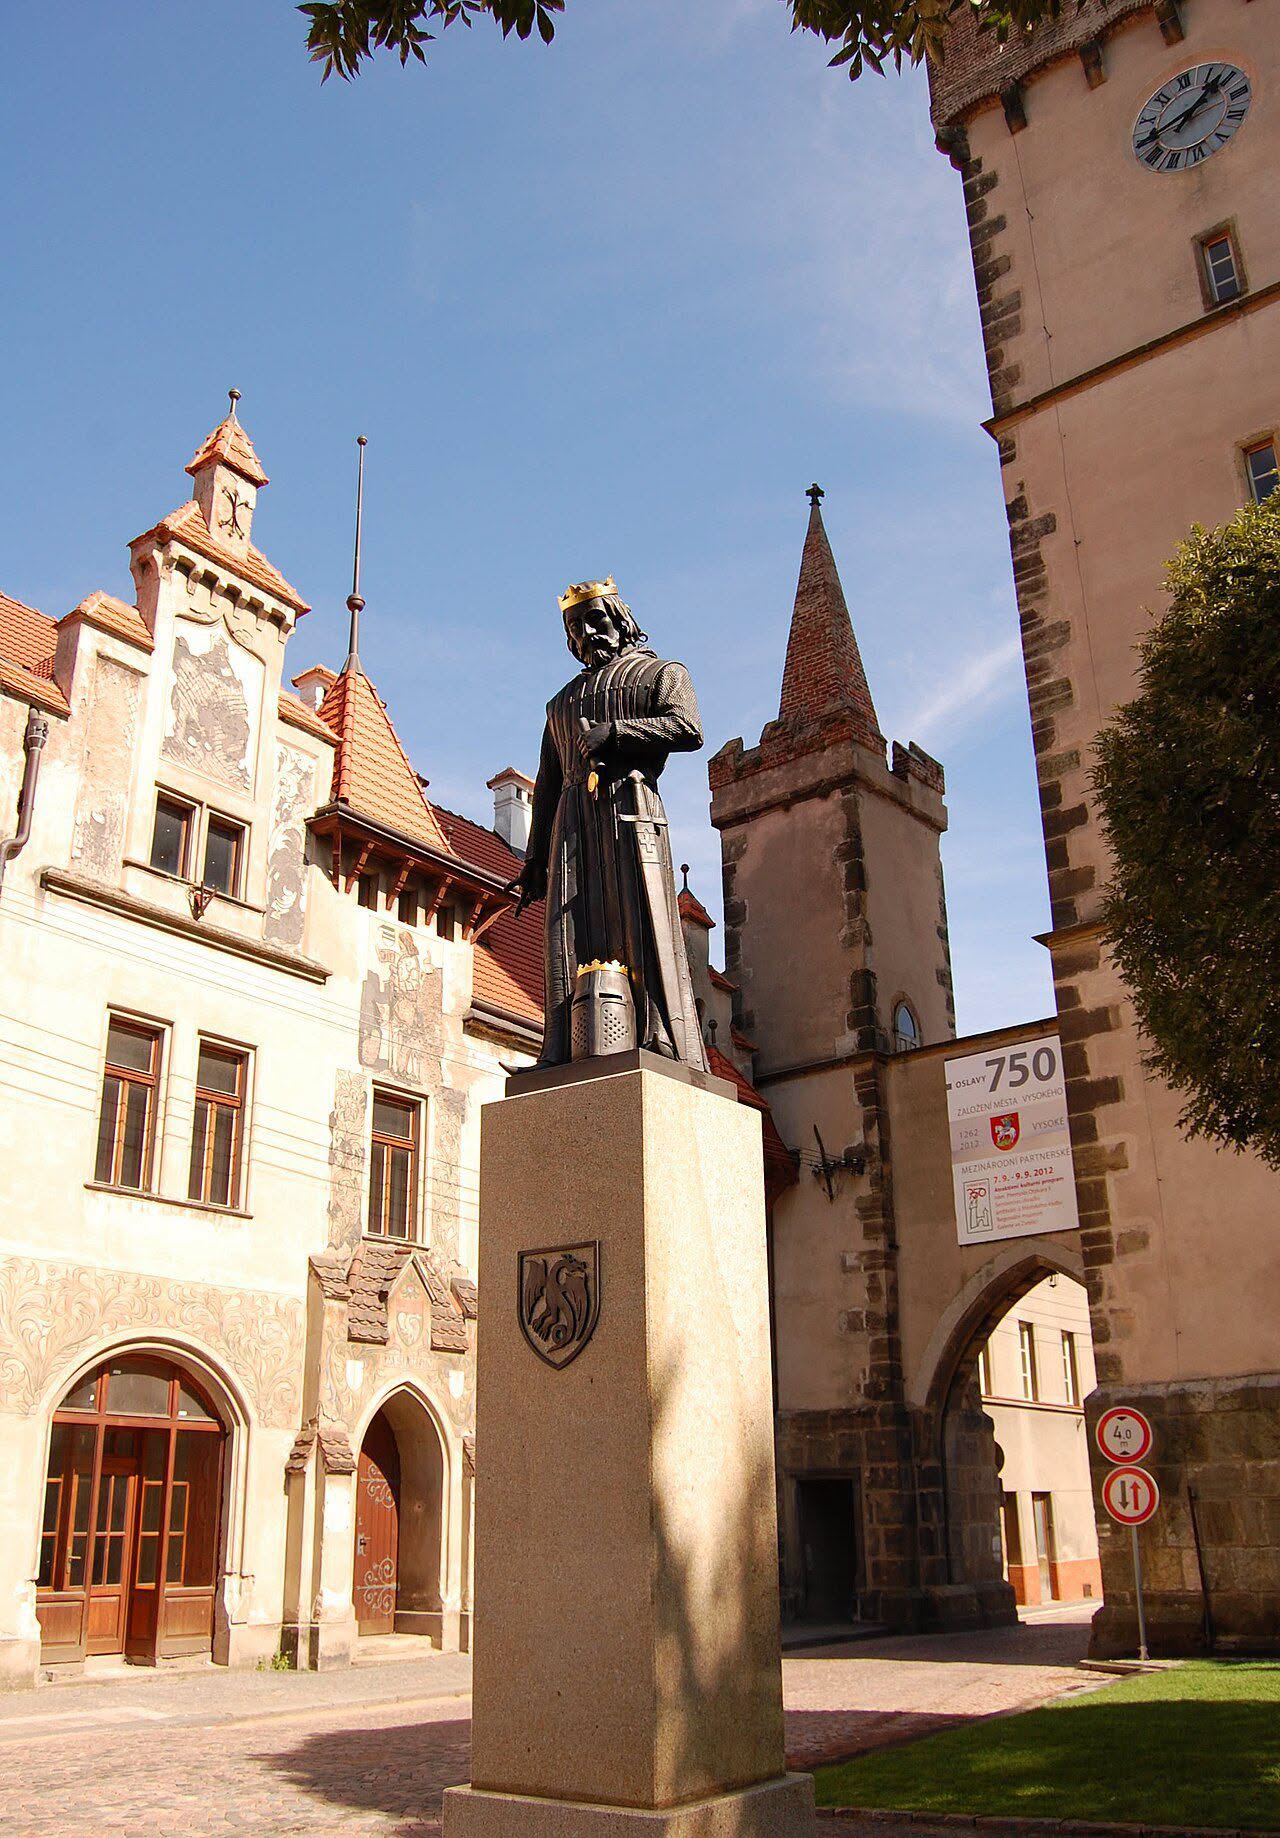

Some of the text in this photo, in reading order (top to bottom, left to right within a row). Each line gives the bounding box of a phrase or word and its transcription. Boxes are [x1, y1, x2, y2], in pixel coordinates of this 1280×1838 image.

[1176, 72, 1191, 92] XII
[1153, 91, 1171, 107] XI
[1229, 84, 1249, 101] III
[1138, 115, 1157, 125] X
[1214, 132, 1230, 143] V
[955, 1046, 1056, 1092] OSLAVY 750
[1022, 1086, 1064, 1103] VYSOKÉHO
[1031, 1116, 1065, 1131] VYSOKÉ
[959, 1128, 979, 1139] 1262
[960, 1140, 980, 1151] 2012
[1033, 1166, 1054, 1177] 2012
